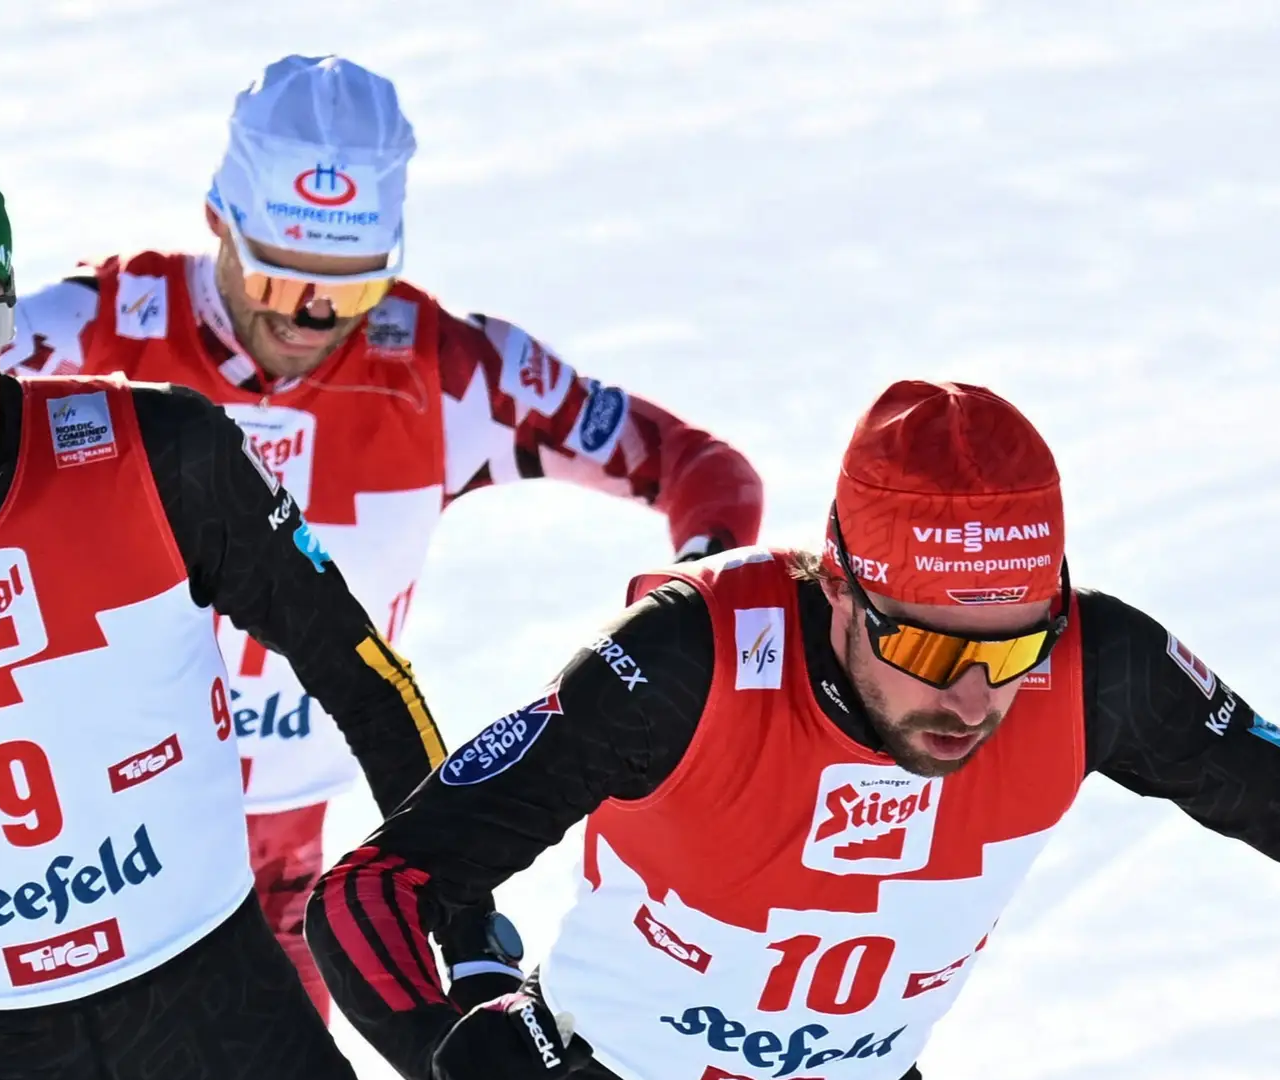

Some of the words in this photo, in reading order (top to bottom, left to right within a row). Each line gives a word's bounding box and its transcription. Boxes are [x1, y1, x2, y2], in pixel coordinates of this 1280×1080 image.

[267, 202, 380, 227] HARREITHER
[55, 421, 94, 435] NORDIC
[56, 425, 108, 443] COMBINED
[58, 438, 86, 449] WORLD
[912, 521, 1051, 553] VIESSMANN
[824, 537, 890, 585] TEREX
[914, 553, 1052, 575] Wärmepumpen
[118, 745, 175, 781] Tirol
[478, 719, 528, 769] shop
[814, 779, 933, 844] Stiegl
[19, 931, 110, 972] Tirol
[644, 916, 700, 962] Tirol
[757, 934, 897, 1016] 10
[660, 1006, 909, 1078] Seefeld
